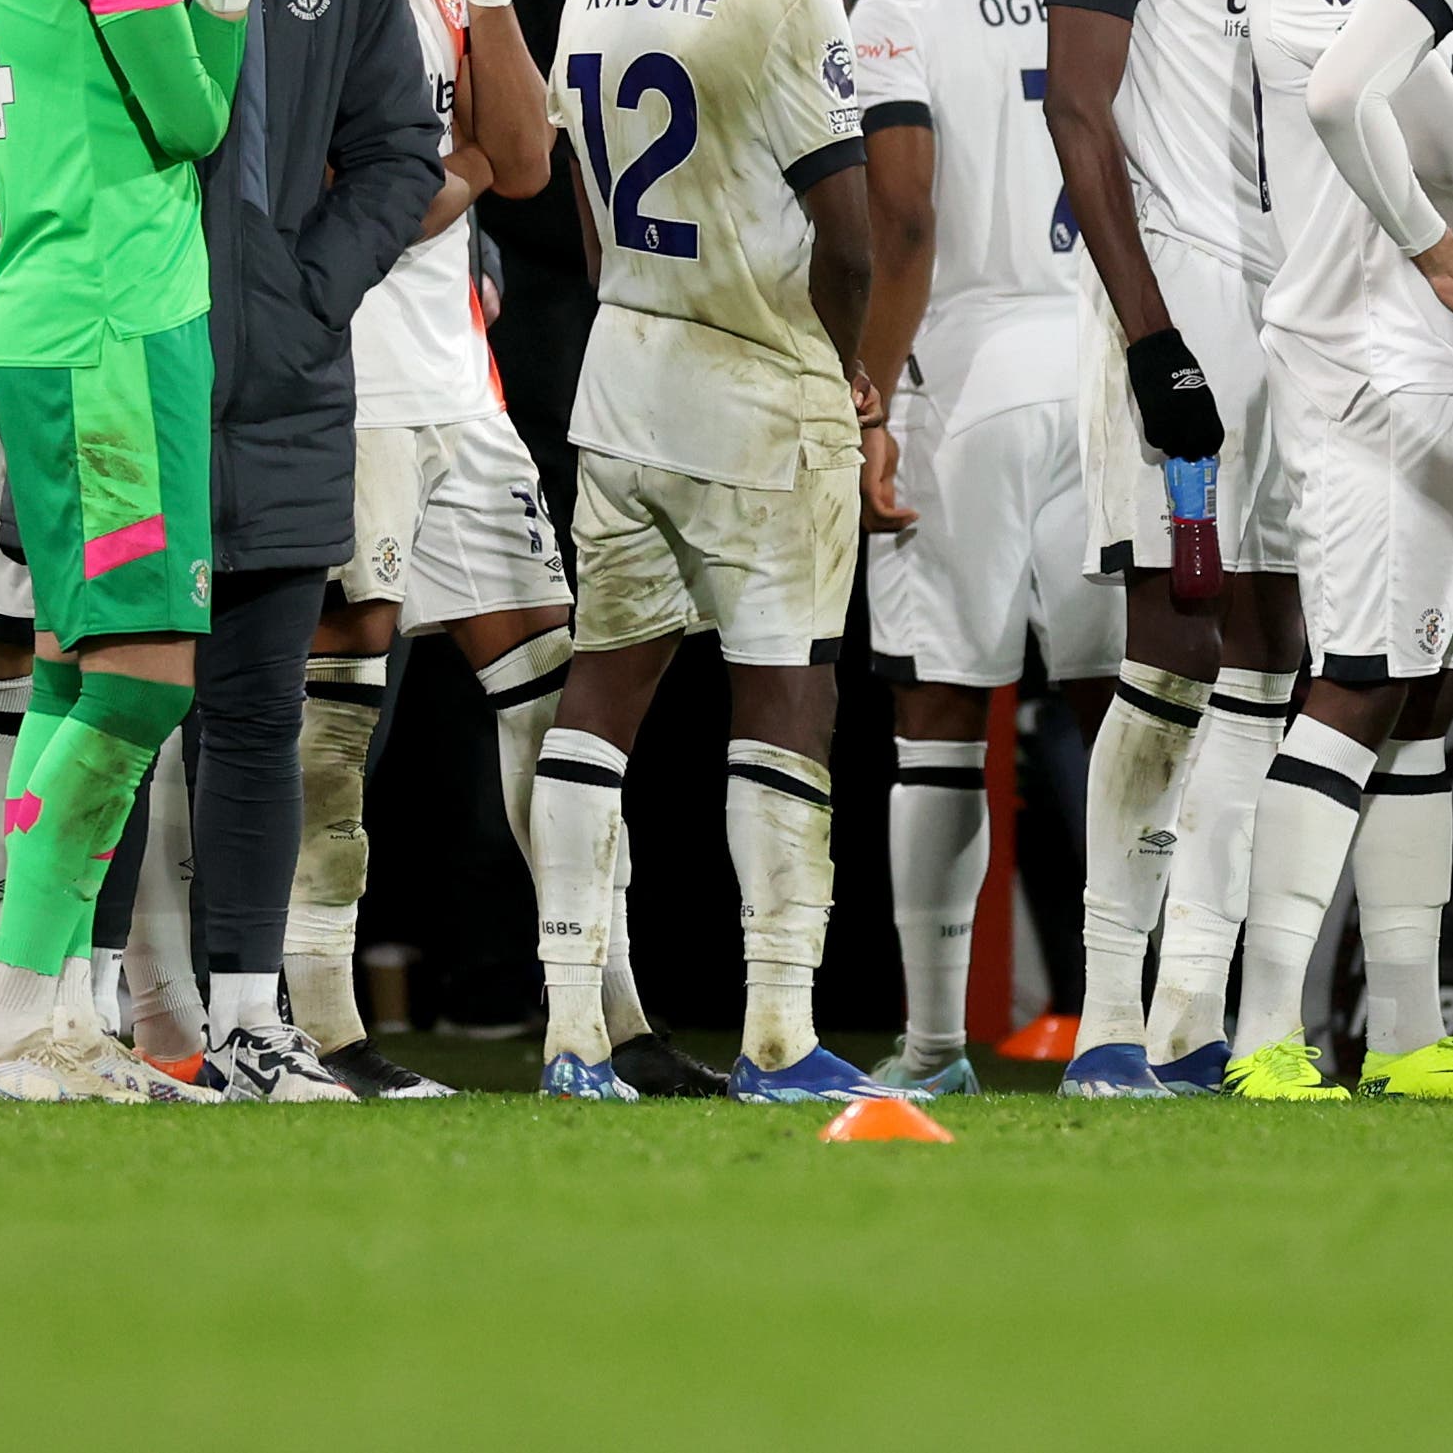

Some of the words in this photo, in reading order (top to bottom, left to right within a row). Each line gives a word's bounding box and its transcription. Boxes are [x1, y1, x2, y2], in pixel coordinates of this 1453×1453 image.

[827, 110, 845, 123] No
[566, 51, 700, 261] 12
[541, 920, 583, 936] 1885
